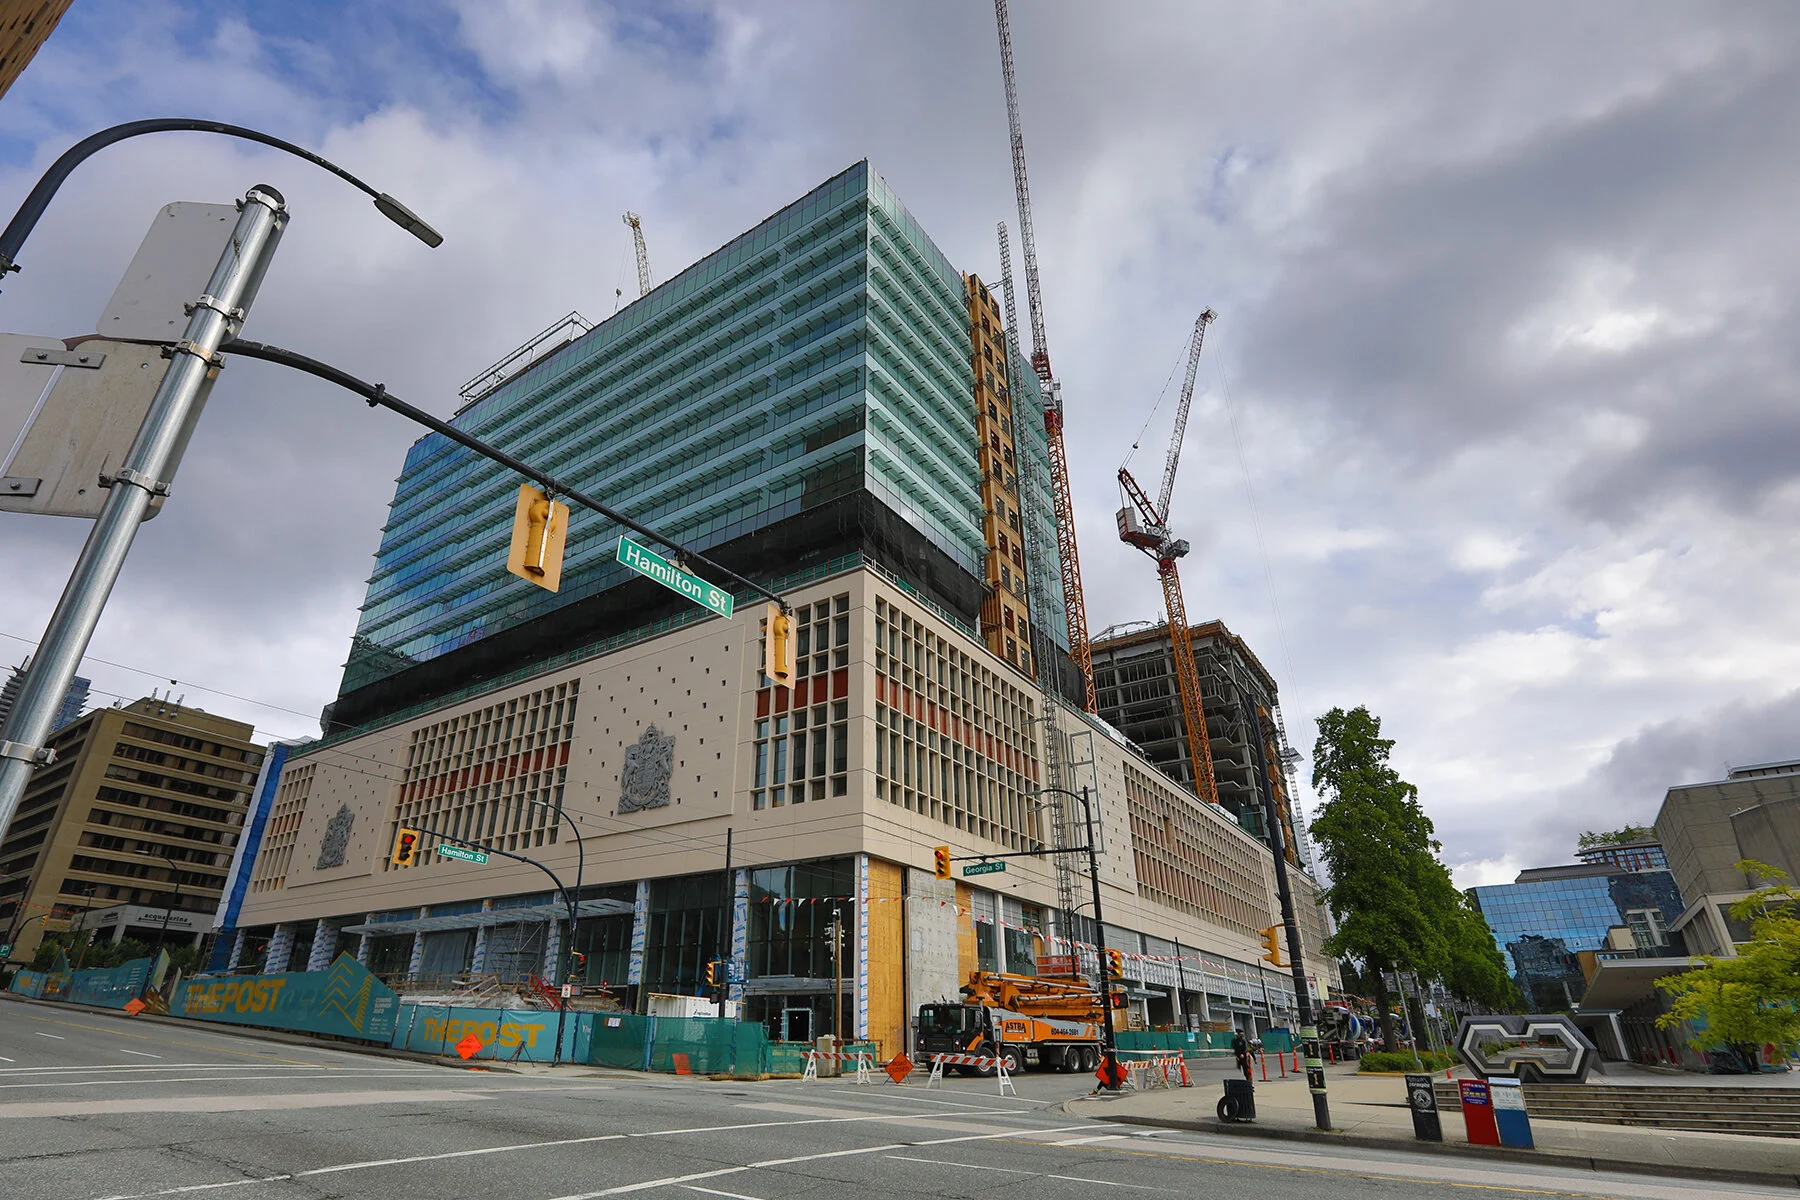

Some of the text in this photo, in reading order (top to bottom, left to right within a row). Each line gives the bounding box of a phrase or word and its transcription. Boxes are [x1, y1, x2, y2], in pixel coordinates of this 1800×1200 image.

[626, 545, 726, 612] Hamilton St
[441, 847, 485, 862] Hamilton St
[965, 862, 1004, 874] Georgia St
[144, 913, 189, 922] acquaarina
[1, 945, 9, 953] P
[1005, 1022, 1027, 1033] ASTRA
